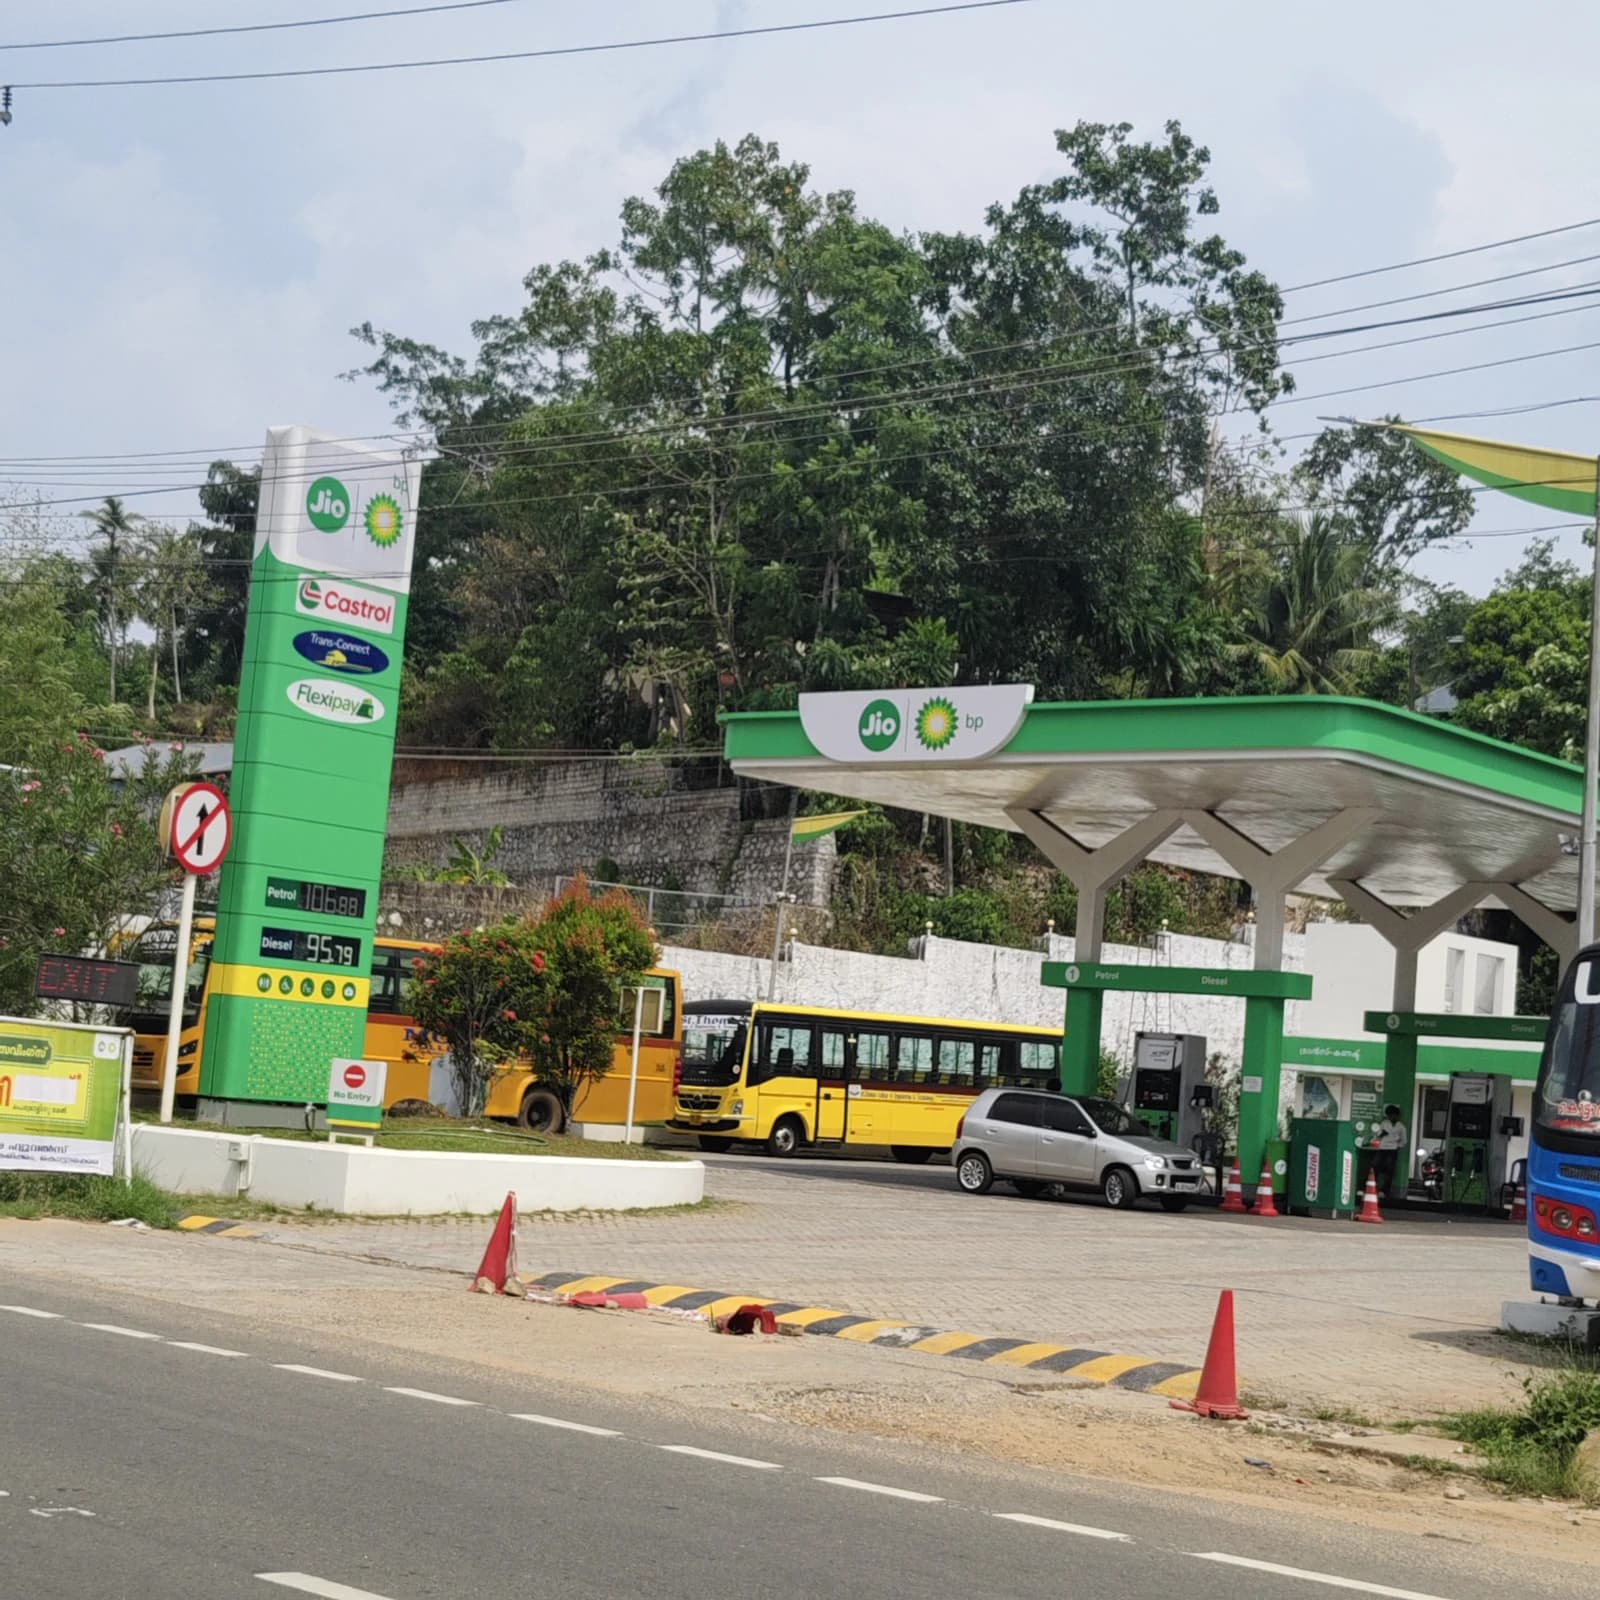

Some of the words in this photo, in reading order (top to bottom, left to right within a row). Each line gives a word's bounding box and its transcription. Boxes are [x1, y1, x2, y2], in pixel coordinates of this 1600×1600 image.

[310, 489, 346, 518] Jio
[324, 591, 392, 624] Castrol
[311, 632, 371, 656] Trans-Connect
[296, 683, 360, 717] Flexipay
[861, 711, 897, 737] Jio
[965, 713, 985, 732] bp
[267, 885, 297, 901] Petrol
[261, 936, 293, 951] Diesel
[39, 960, 118, 994] EXIT
[1095, 970, 1120, 981] Petrol
[1201, 975, 1229, 986] Diesel
[1511, 1024, 1536, 1033] Diesel
[334, 1091, 346, 1099] No
[347, 1092, 372, 1102] Entry
[1307, 1152, 1318, 1188] Castrol
